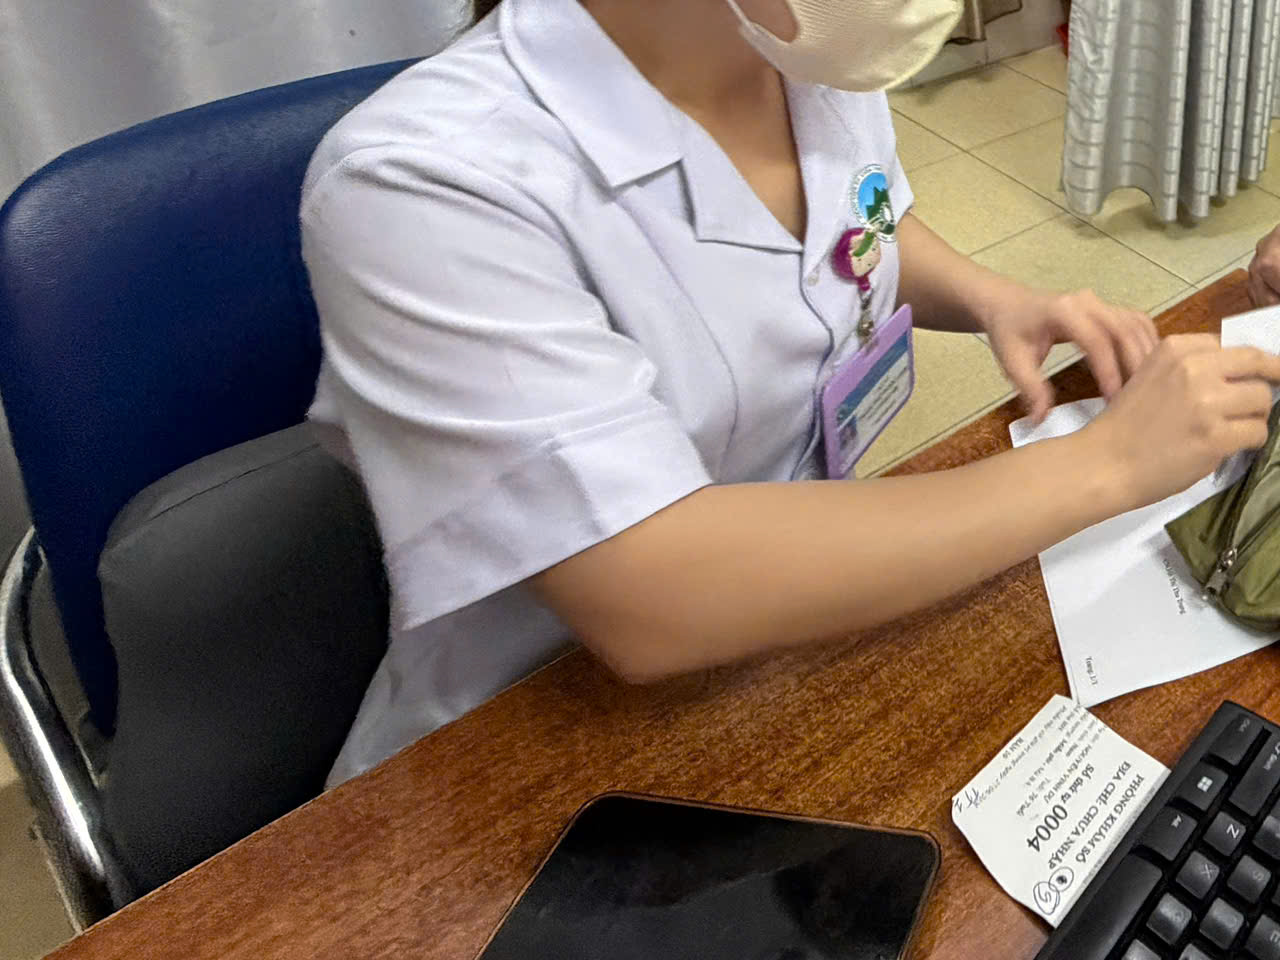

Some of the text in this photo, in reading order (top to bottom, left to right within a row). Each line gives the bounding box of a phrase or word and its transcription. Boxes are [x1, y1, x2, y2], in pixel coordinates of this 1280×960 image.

[1081, 763, 1094, 780] Số
[1112, 760, 1131, 780] ĐỊA
[1026, 804, 1068, 852] 0004
[1070, 805, 1099, 836] CHƯA
[1075, 773, 1145, 863] PHÒNG KHÁM SỐ
[1226, 823, 1240, 838] Z
[1047, 836, 1075, 873] NHẬP
